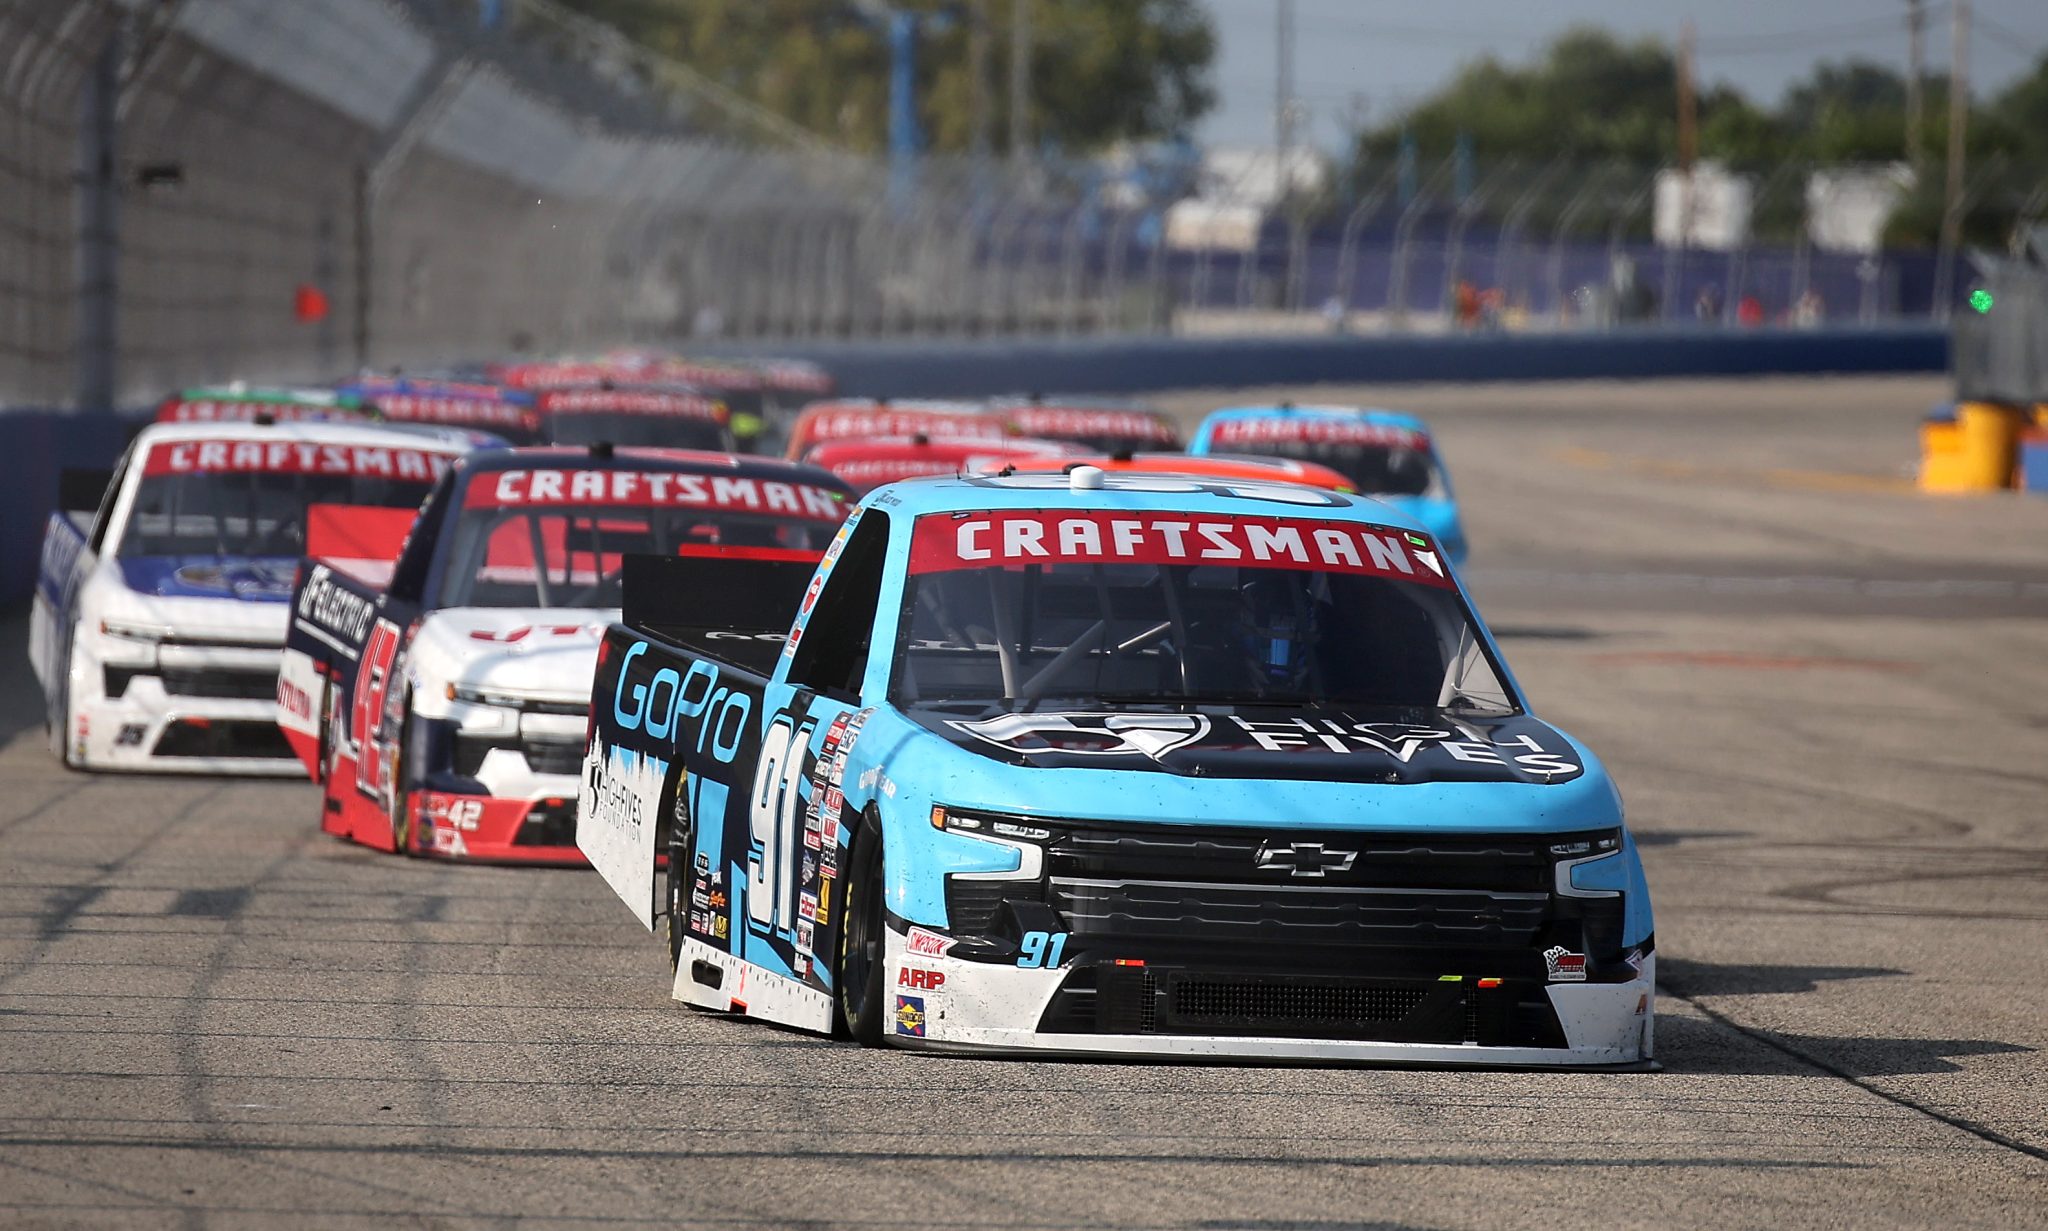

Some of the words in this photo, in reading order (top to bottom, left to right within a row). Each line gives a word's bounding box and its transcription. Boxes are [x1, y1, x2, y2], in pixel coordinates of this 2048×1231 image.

[495, 469, 840, 519] CRAFTSMAN
[956, 518, 1415, 575] CRAFTSMAN
[614, 641, 751, 764] GoPro
[1249, 730, 1579, 774] FIVES
[447, 799, 484, 832] 42
[599, 800, 641, 844] FOUNDATION
[747, 714, 813, 938] 91
[908, 931, 949, 956] SIMPSON
[1016, 930, 1068, 970] 91
[897, 967, 946, 990] ARP
[896, 1011, 923, 1023] SUNOCO
